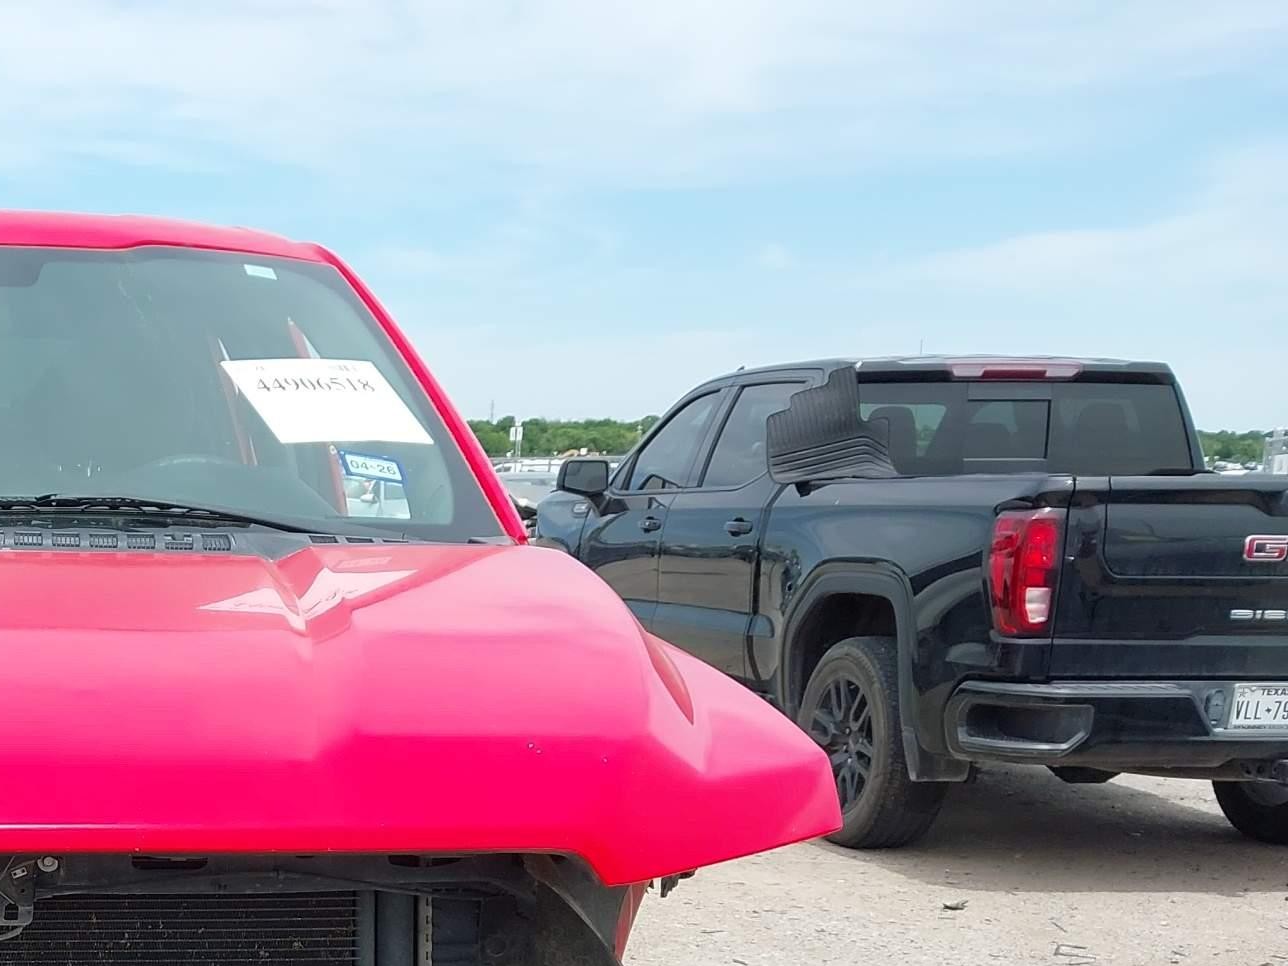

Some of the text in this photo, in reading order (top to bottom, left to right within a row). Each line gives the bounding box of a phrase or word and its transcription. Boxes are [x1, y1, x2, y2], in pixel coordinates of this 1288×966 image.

[256, 377, 376, 392] 44906518
[350, 459, 397, 475] 04-26
[1236, 700, 1262, 720] VLL
